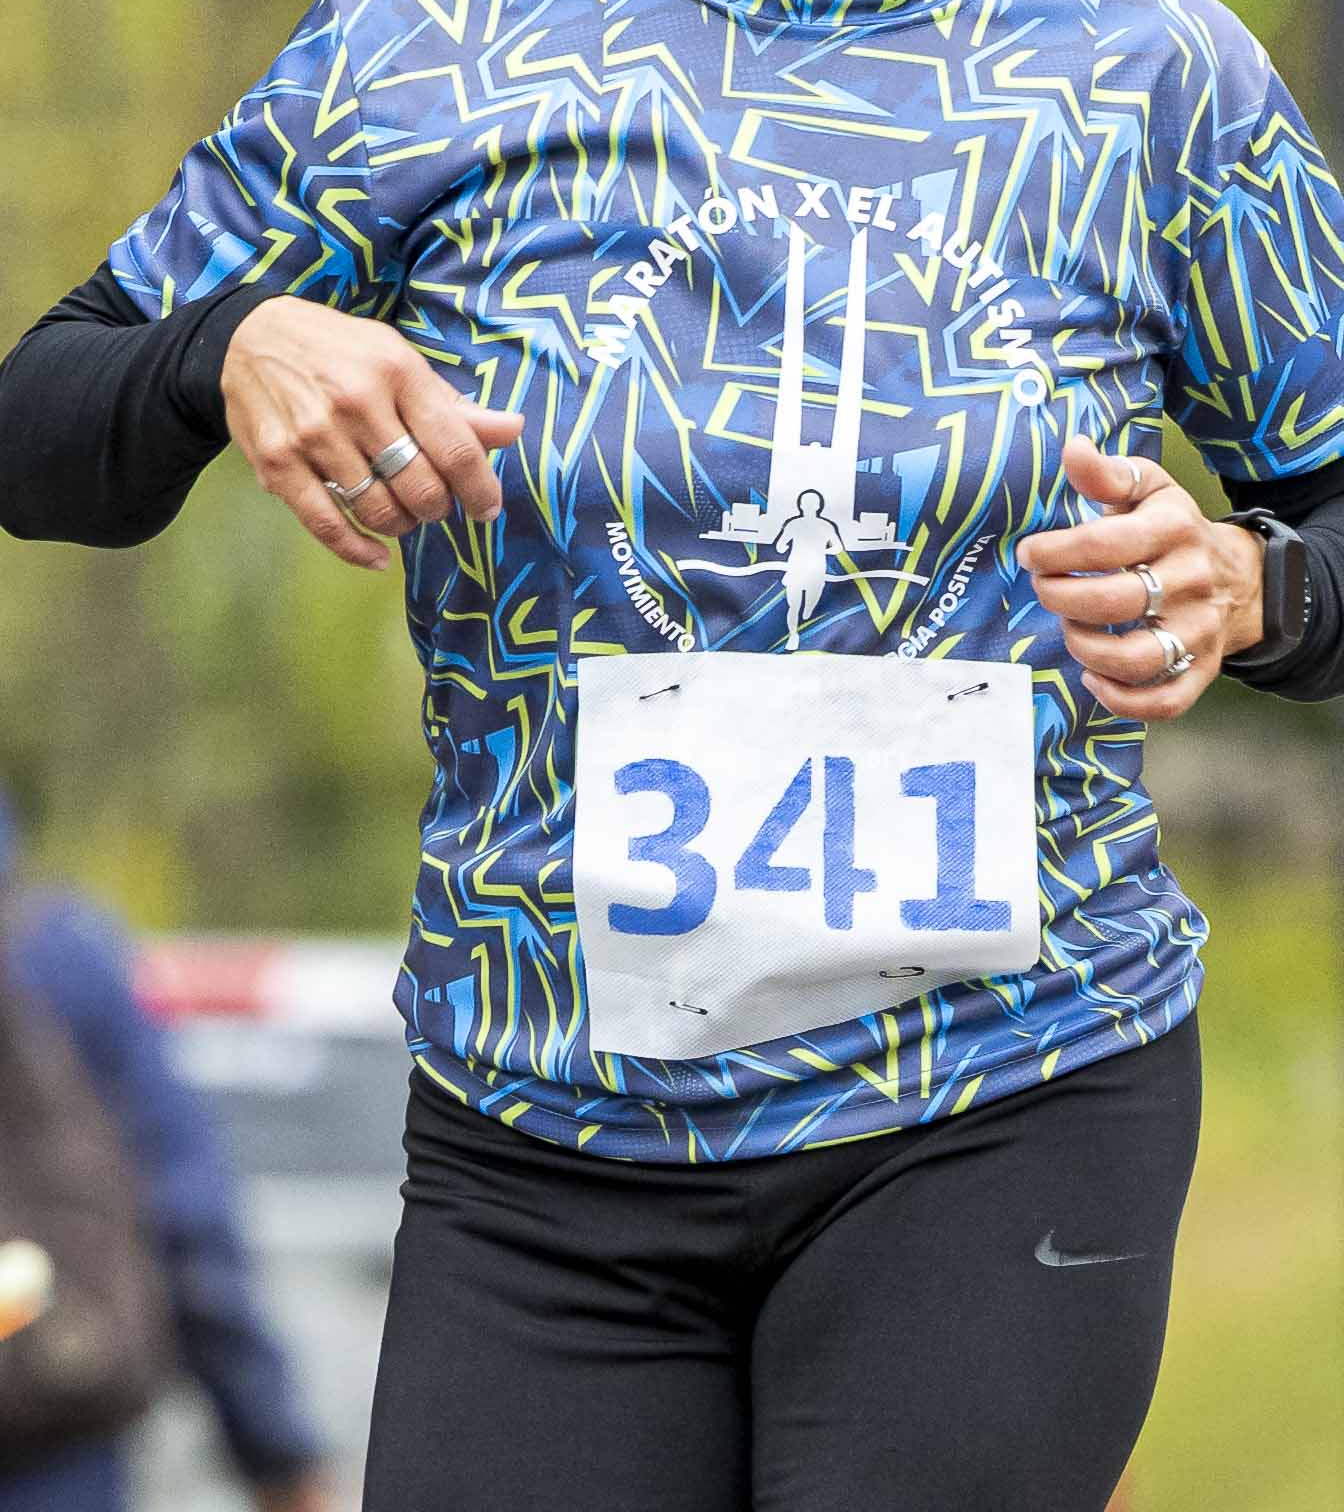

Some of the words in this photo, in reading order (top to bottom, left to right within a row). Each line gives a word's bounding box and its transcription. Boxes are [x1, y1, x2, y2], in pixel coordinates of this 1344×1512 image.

[586, 184, 779, 369] MARATÓN
[794, 182, 831, 219] X
[846, 186, 897, 232] EL
[905, 211, 1047, 407] AUTISMO
[605, 521, 695, 653] MOVIMIENTO
[884, 625, 937, 660] GIA
[928, 534, 997, 627] POSITIVA
[607, 756, 1013, 937] 341
